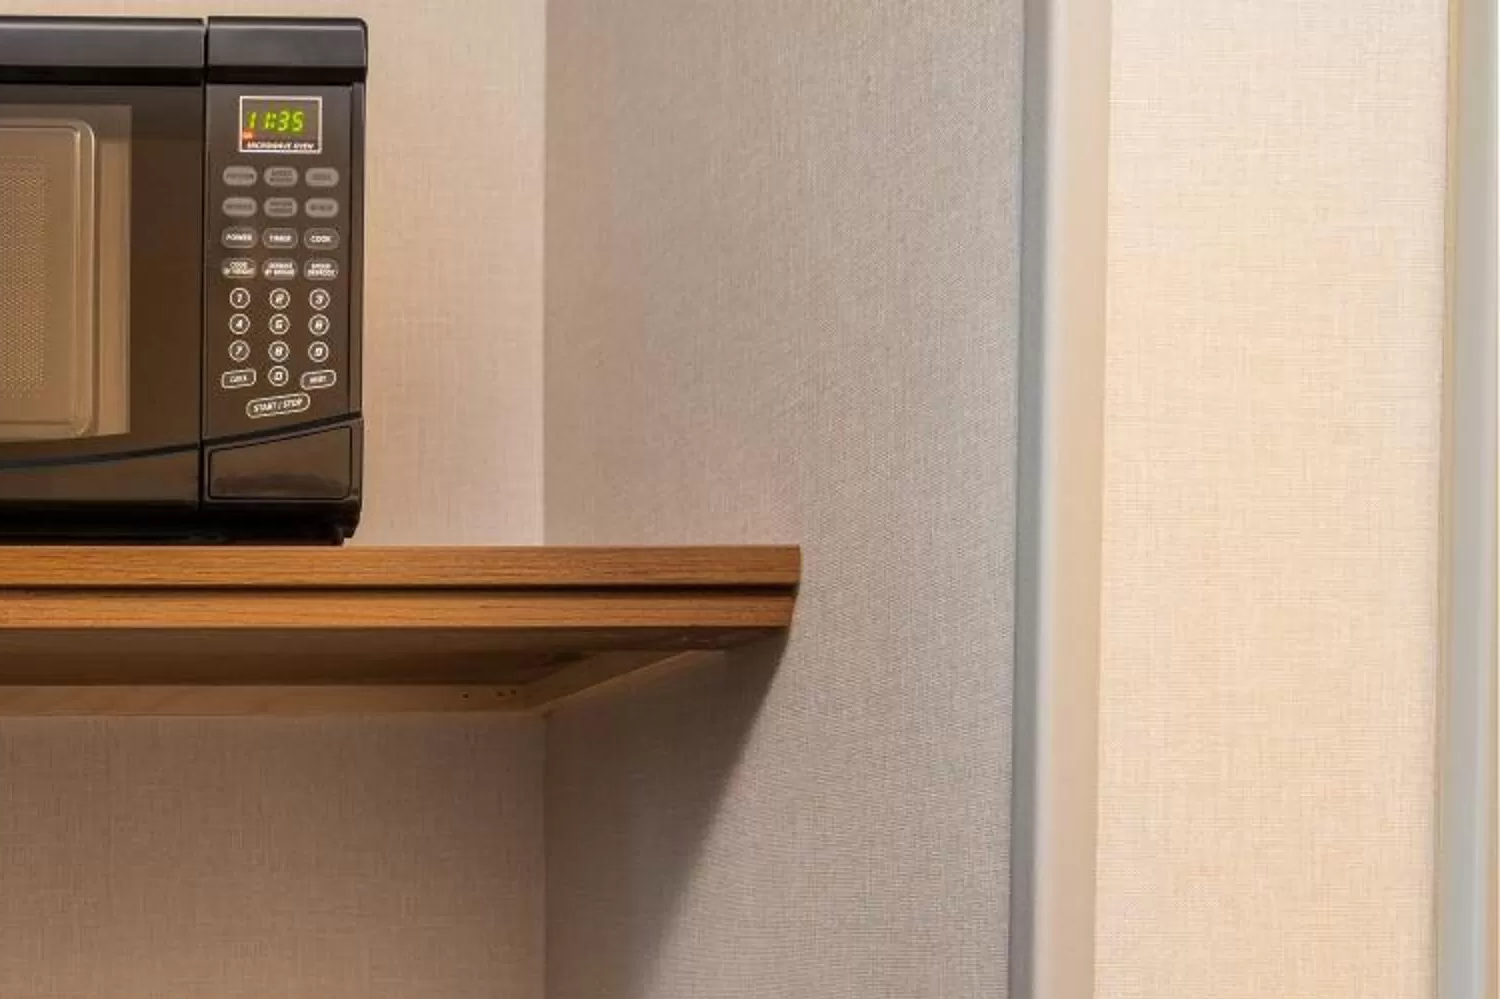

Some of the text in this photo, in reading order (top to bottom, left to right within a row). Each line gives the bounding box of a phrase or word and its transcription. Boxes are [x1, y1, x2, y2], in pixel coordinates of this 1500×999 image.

[249, 110, 305, 132] 11:35
[253, 401, 277, 413] START
[283, 397, 303, 408] STOP
